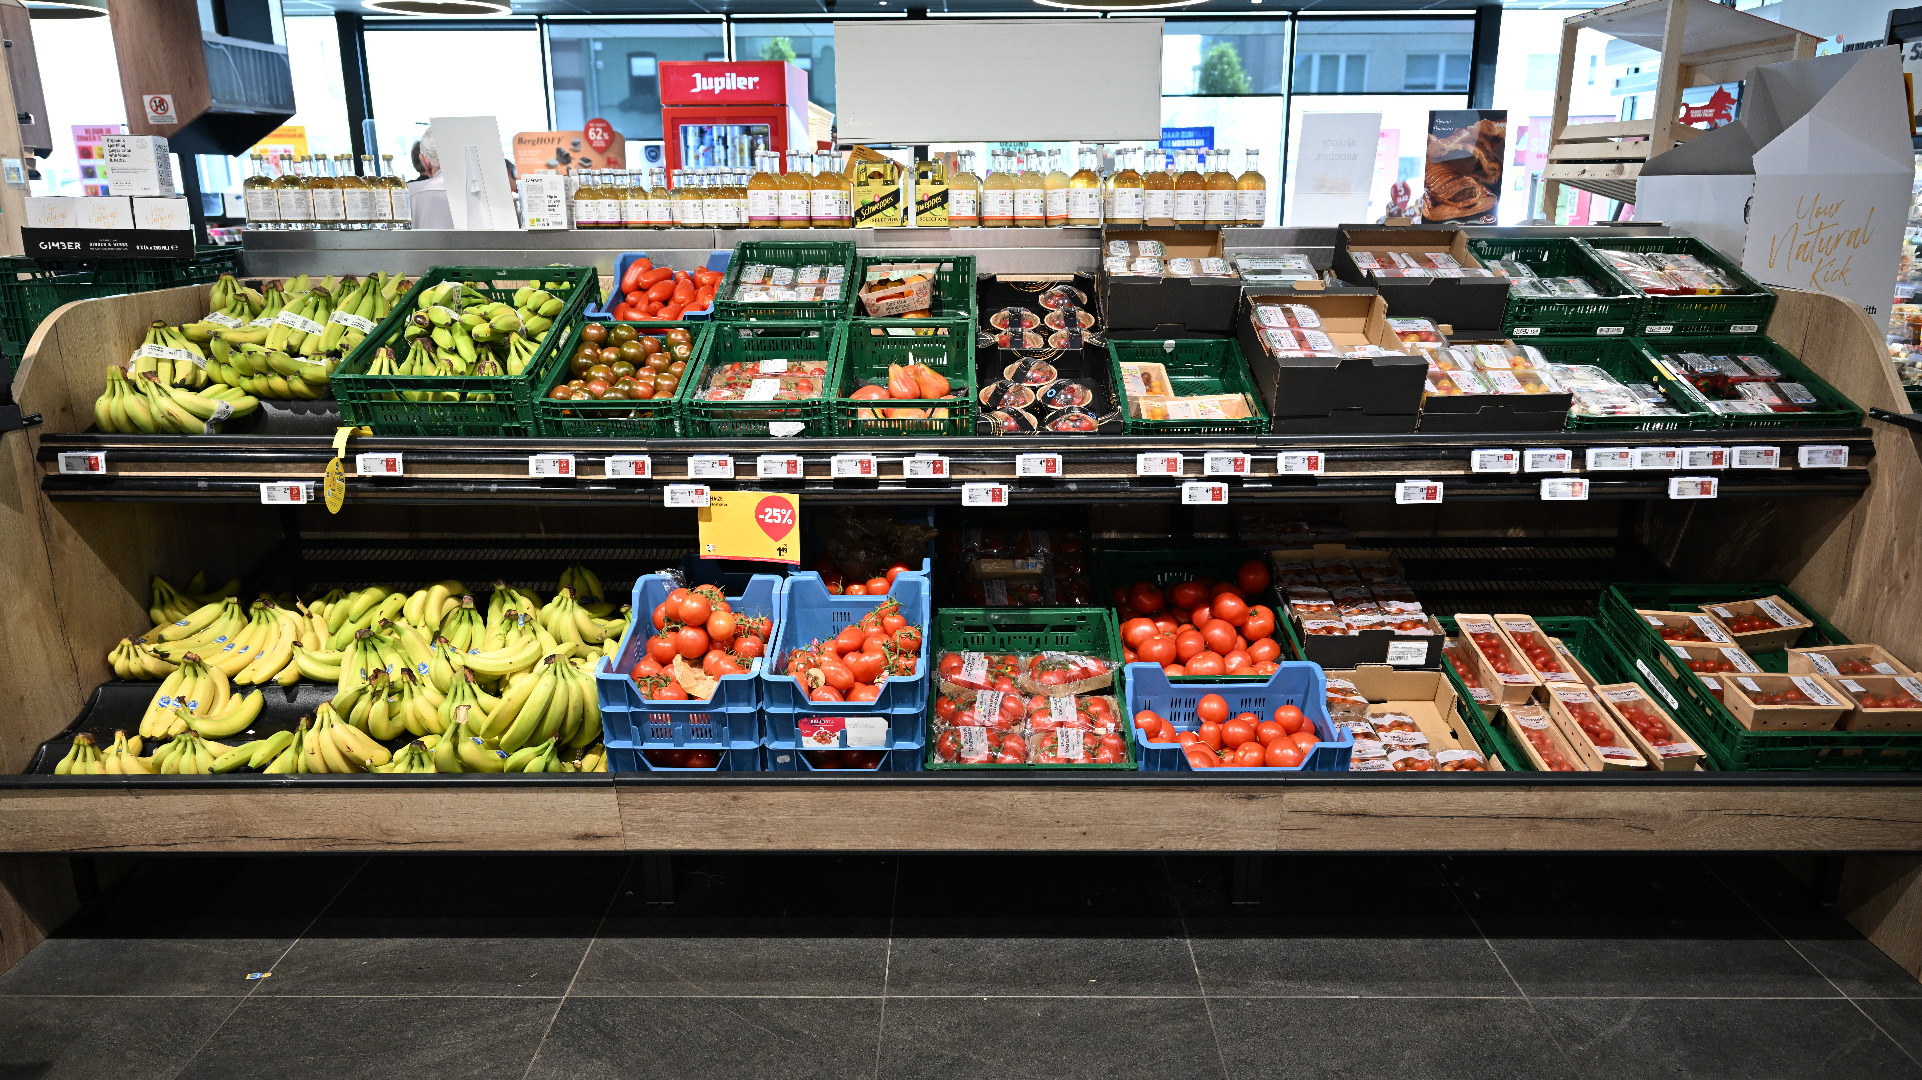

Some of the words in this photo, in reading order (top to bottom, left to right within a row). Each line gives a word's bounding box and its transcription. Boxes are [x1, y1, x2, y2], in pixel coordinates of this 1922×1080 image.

[518, 136, 563, 147] BergHOFF
[588, 127, 610, 140] 62%
[861, 194, 894, 219] Schweppes
[1797, 192, 1846, 230] Your
[1768, 207, 1876, 273] Natural
[1810, 255, 1853, 292] Kick
[758, 507, 793, 525] -25%
